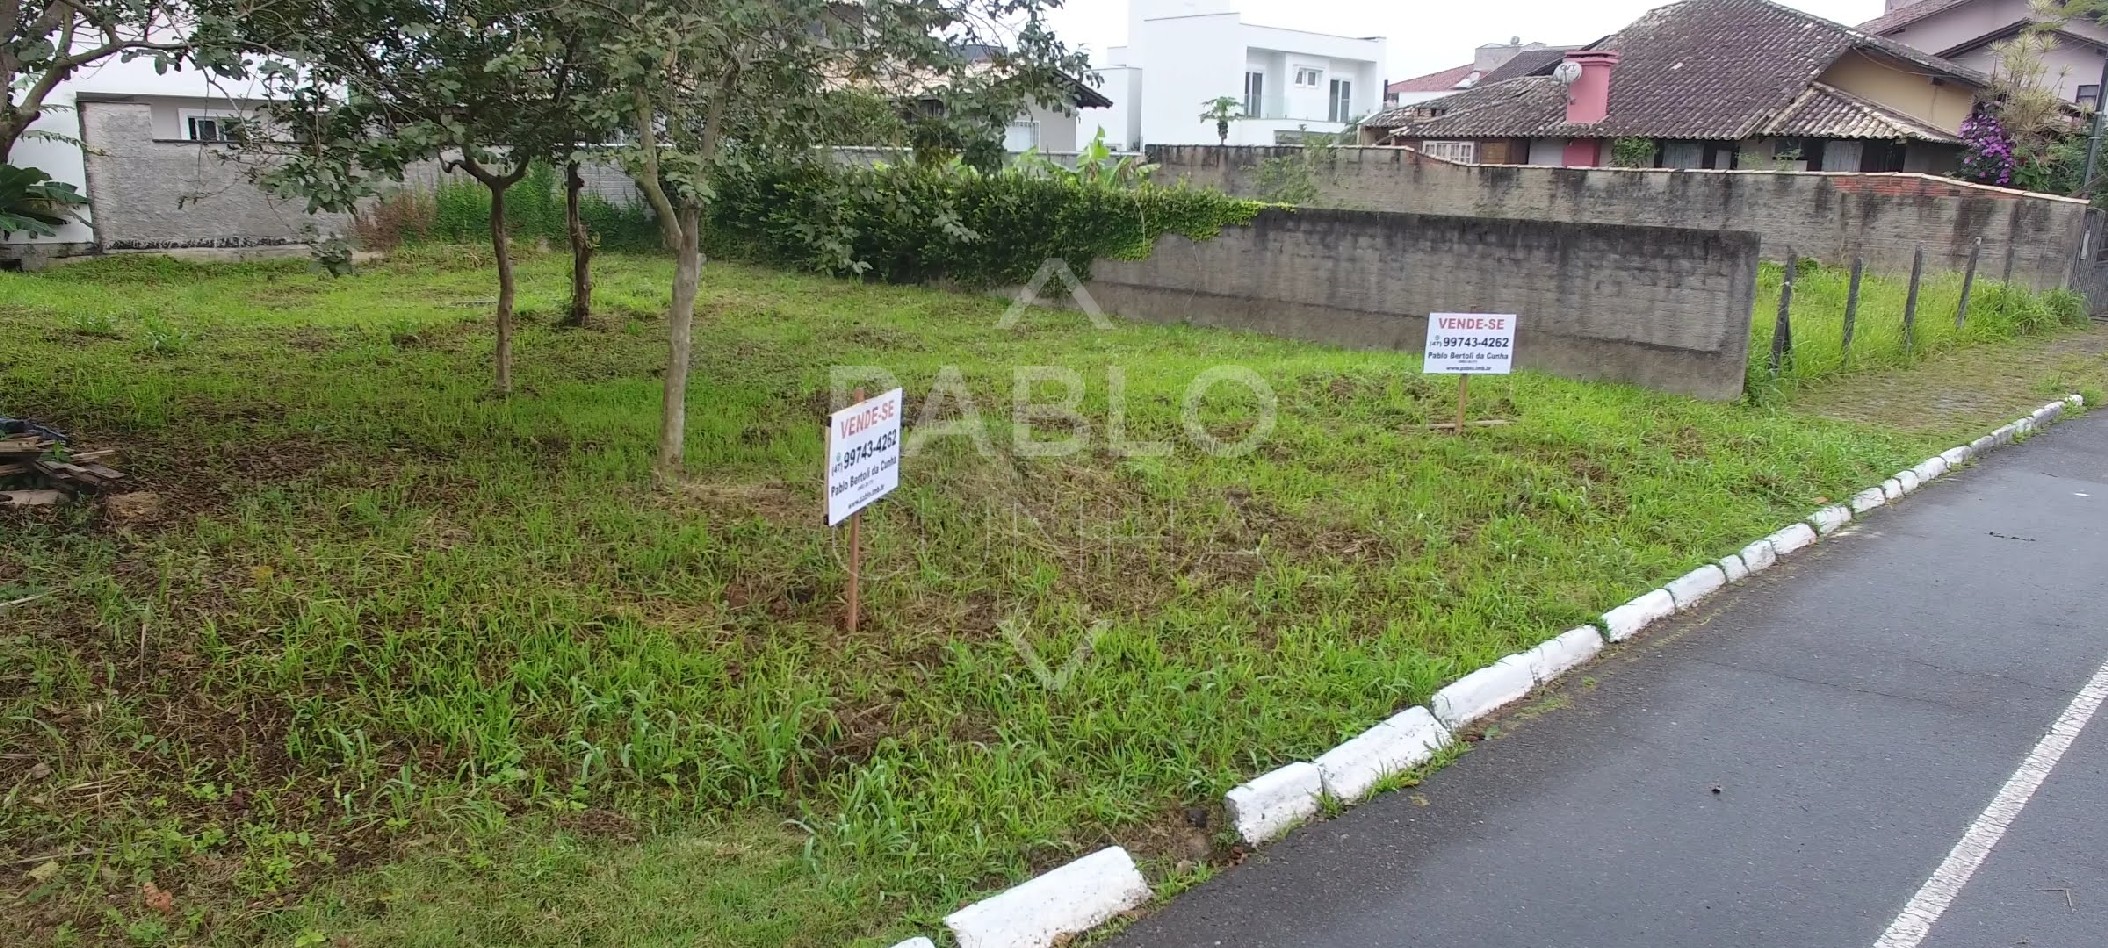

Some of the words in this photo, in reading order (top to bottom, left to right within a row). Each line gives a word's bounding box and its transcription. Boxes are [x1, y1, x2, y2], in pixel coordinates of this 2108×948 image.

[1438, 318, 1505, 330] VENDE-SE
[1443, 337, 1509, 347] 99743-4262
[1450, 352, 1473, 360] Bertoli
[1476, 352, 1484, 360] da
[1487, 352, 1509, 360] Cunha
[840, 400, 895, 439] VENDE-SE
[844, 429, 897, 469] 99743-4262
[831, 479, 849, 497] Pablo
[850, 466, 871, 488] Bertoli
[872, 463, 879, 476] da
[880, 456, 897, 472] Cunha
